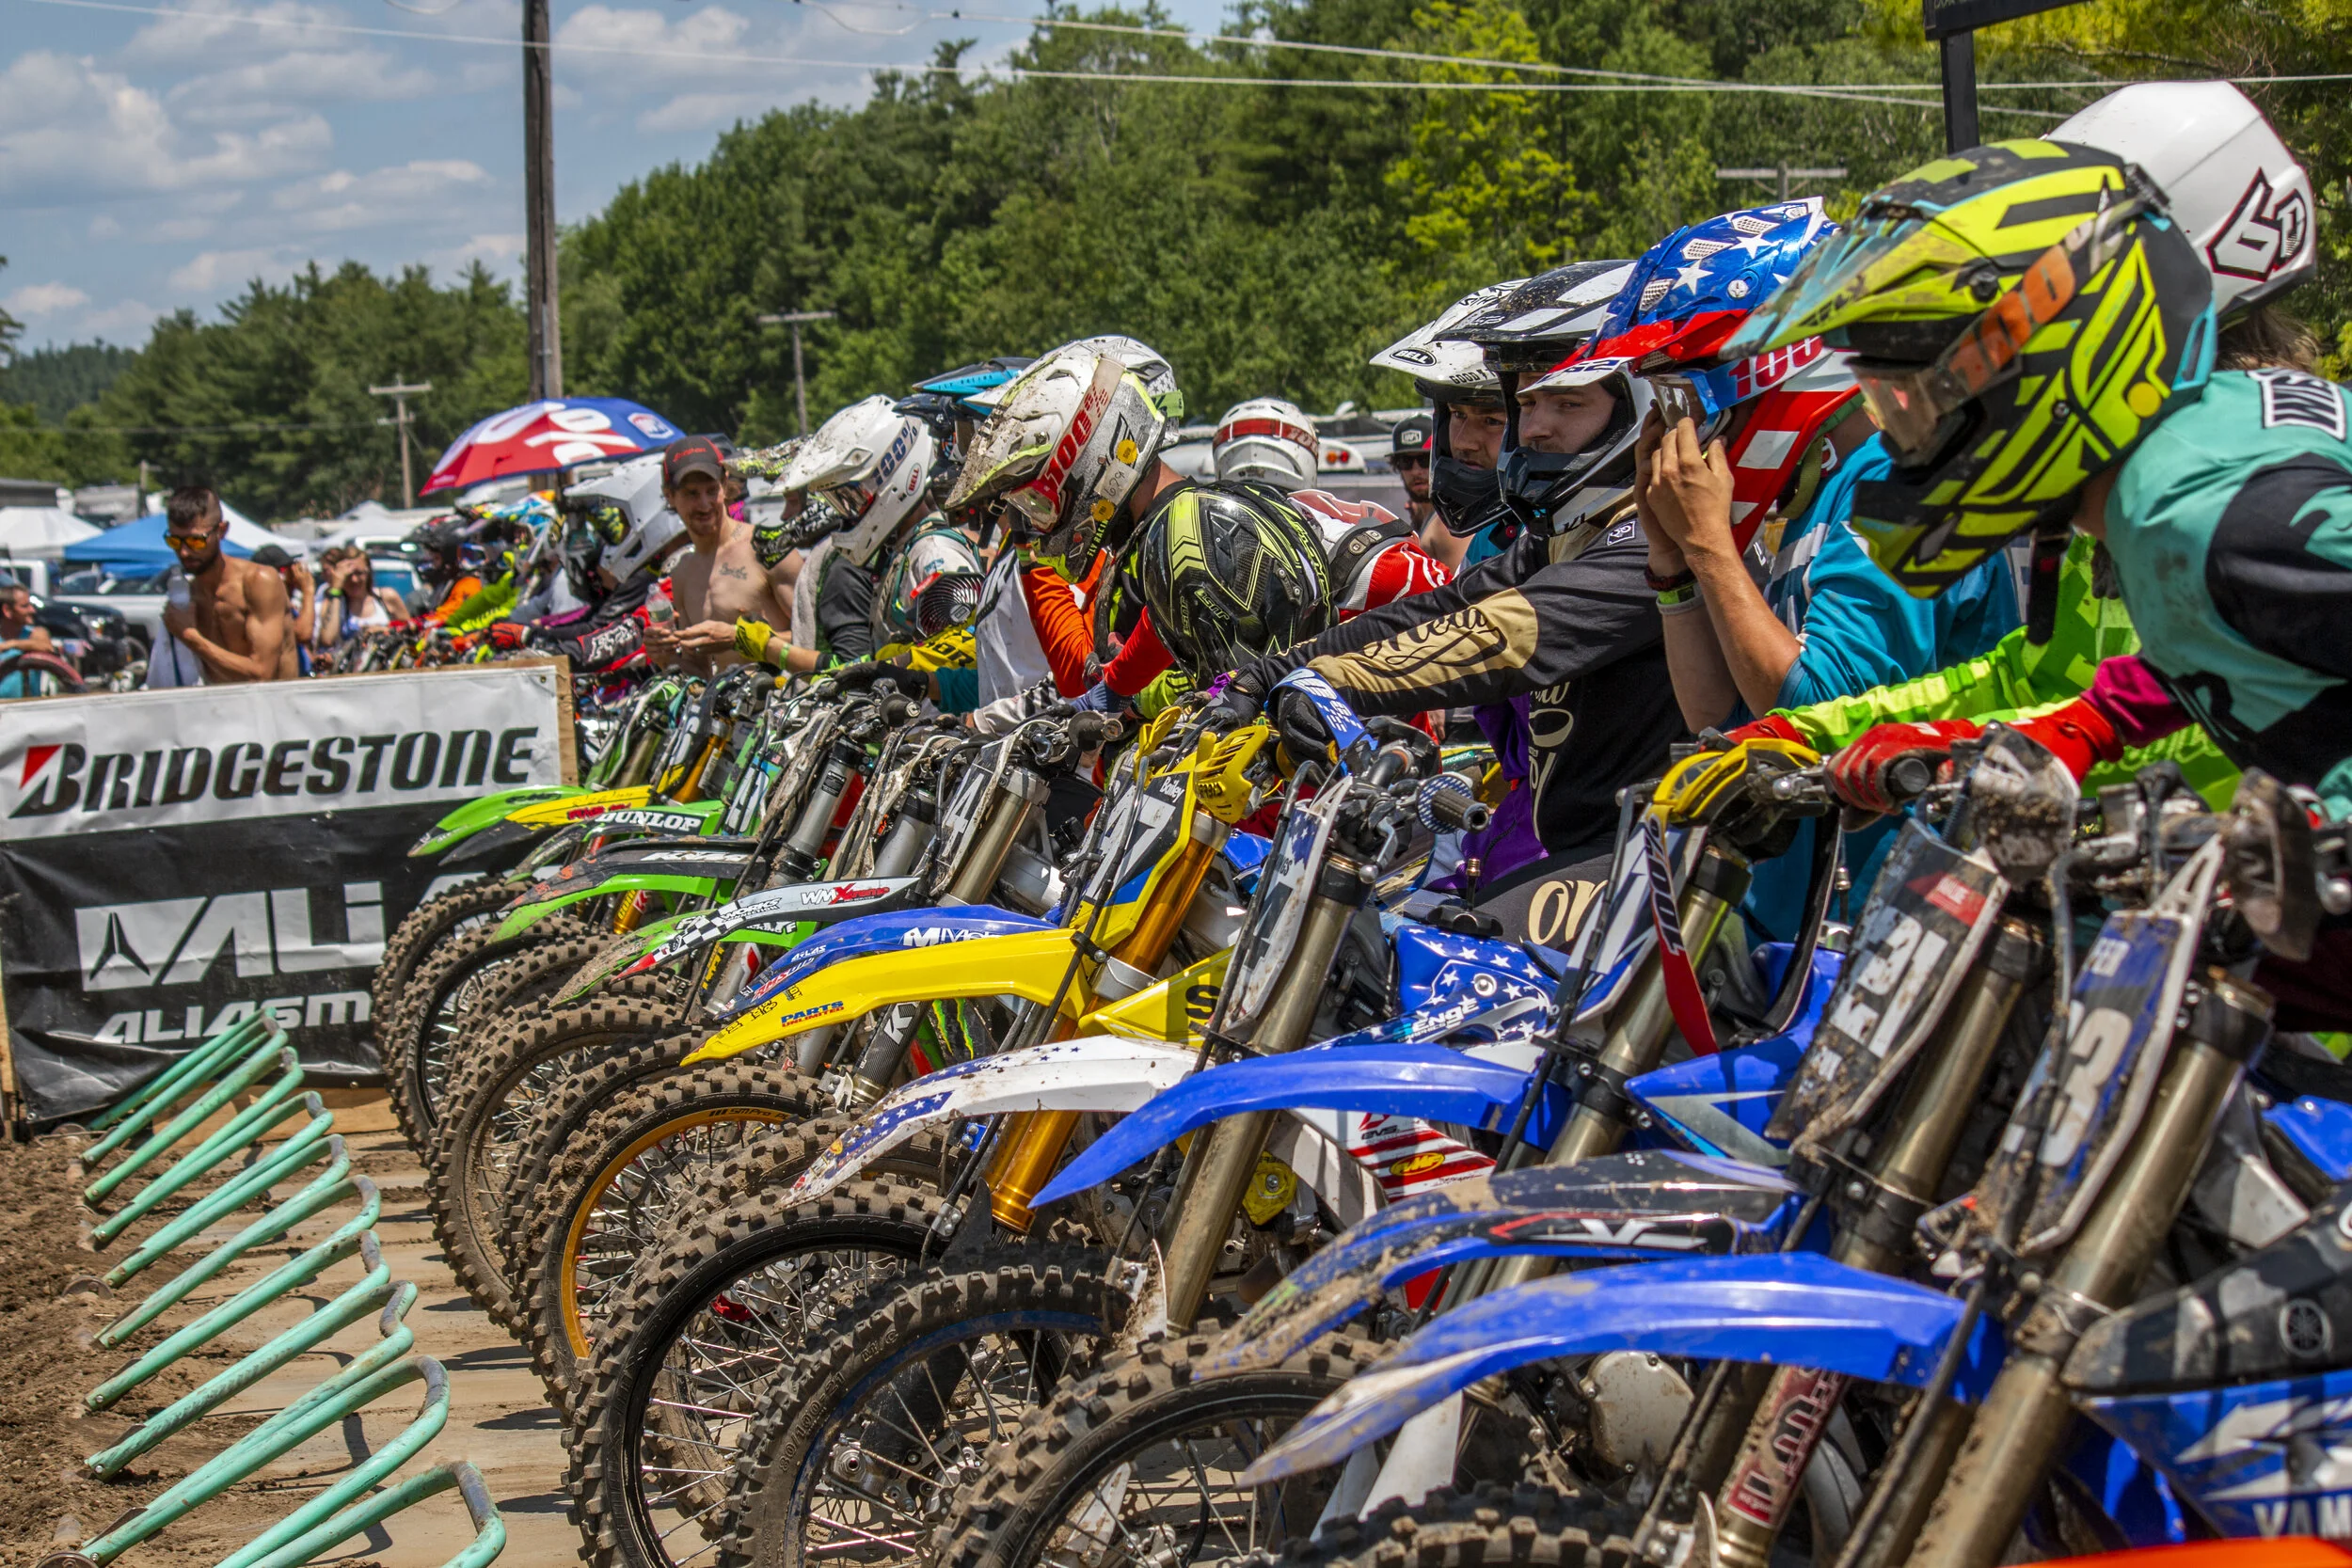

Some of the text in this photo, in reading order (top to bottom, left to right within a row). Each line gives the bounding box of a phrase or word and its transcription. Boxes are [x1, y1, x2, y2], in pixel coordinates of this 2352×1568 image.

[1395, 350, 1429, 364] BELL
[1450, 369, 1480, 385] GOOD
[1044, 383, 1109, 494] 100%
[872, 420, 918, 486] 100%
[908, 467, 920, 492] BELL
[9, 727, 539, 819] BRIDGESTONE
[1159, 776, 1185, 803] Bailey
[595, 812, 701, 832] DUNLOP
[781, 1001, 844, 1022] PARTS
[782, 1006, 845, 1028] UNLIMITED
